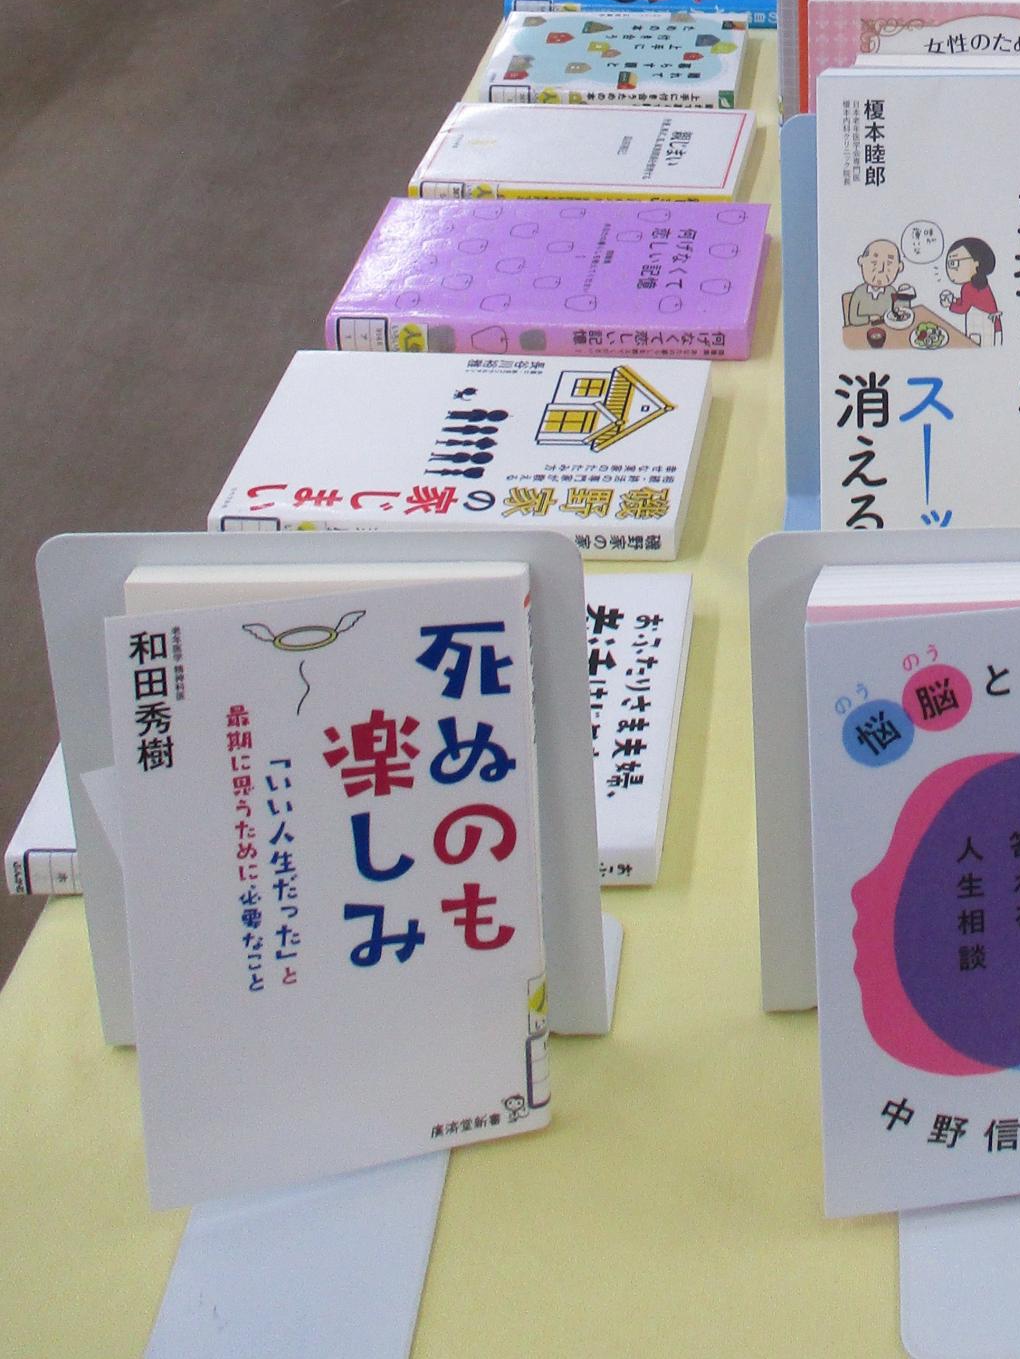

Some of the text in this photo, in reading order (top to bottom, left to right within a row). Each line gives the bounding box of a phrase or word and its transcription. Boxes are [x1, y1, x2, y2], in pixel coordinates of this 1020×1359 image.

[863, 99, 886, 187] 榎本睦郎
[665, 228, 698, 290] 何げなくて
[247, 483, 672, 519] 磯野家の家じまい
[835, 370, 891, 530] 消える
[128, 630, 174, 773] 和田秀樹
[226, 704, 265, 994] 最期に思うために必要なこと
[322, 707, 425, 968] 楽しみ
[415, 620, 518, 952] 死ぬのも
[264, 757, 301, 986] 「いい人生だった」と
[956, 836, 988, 972] 人生相談
